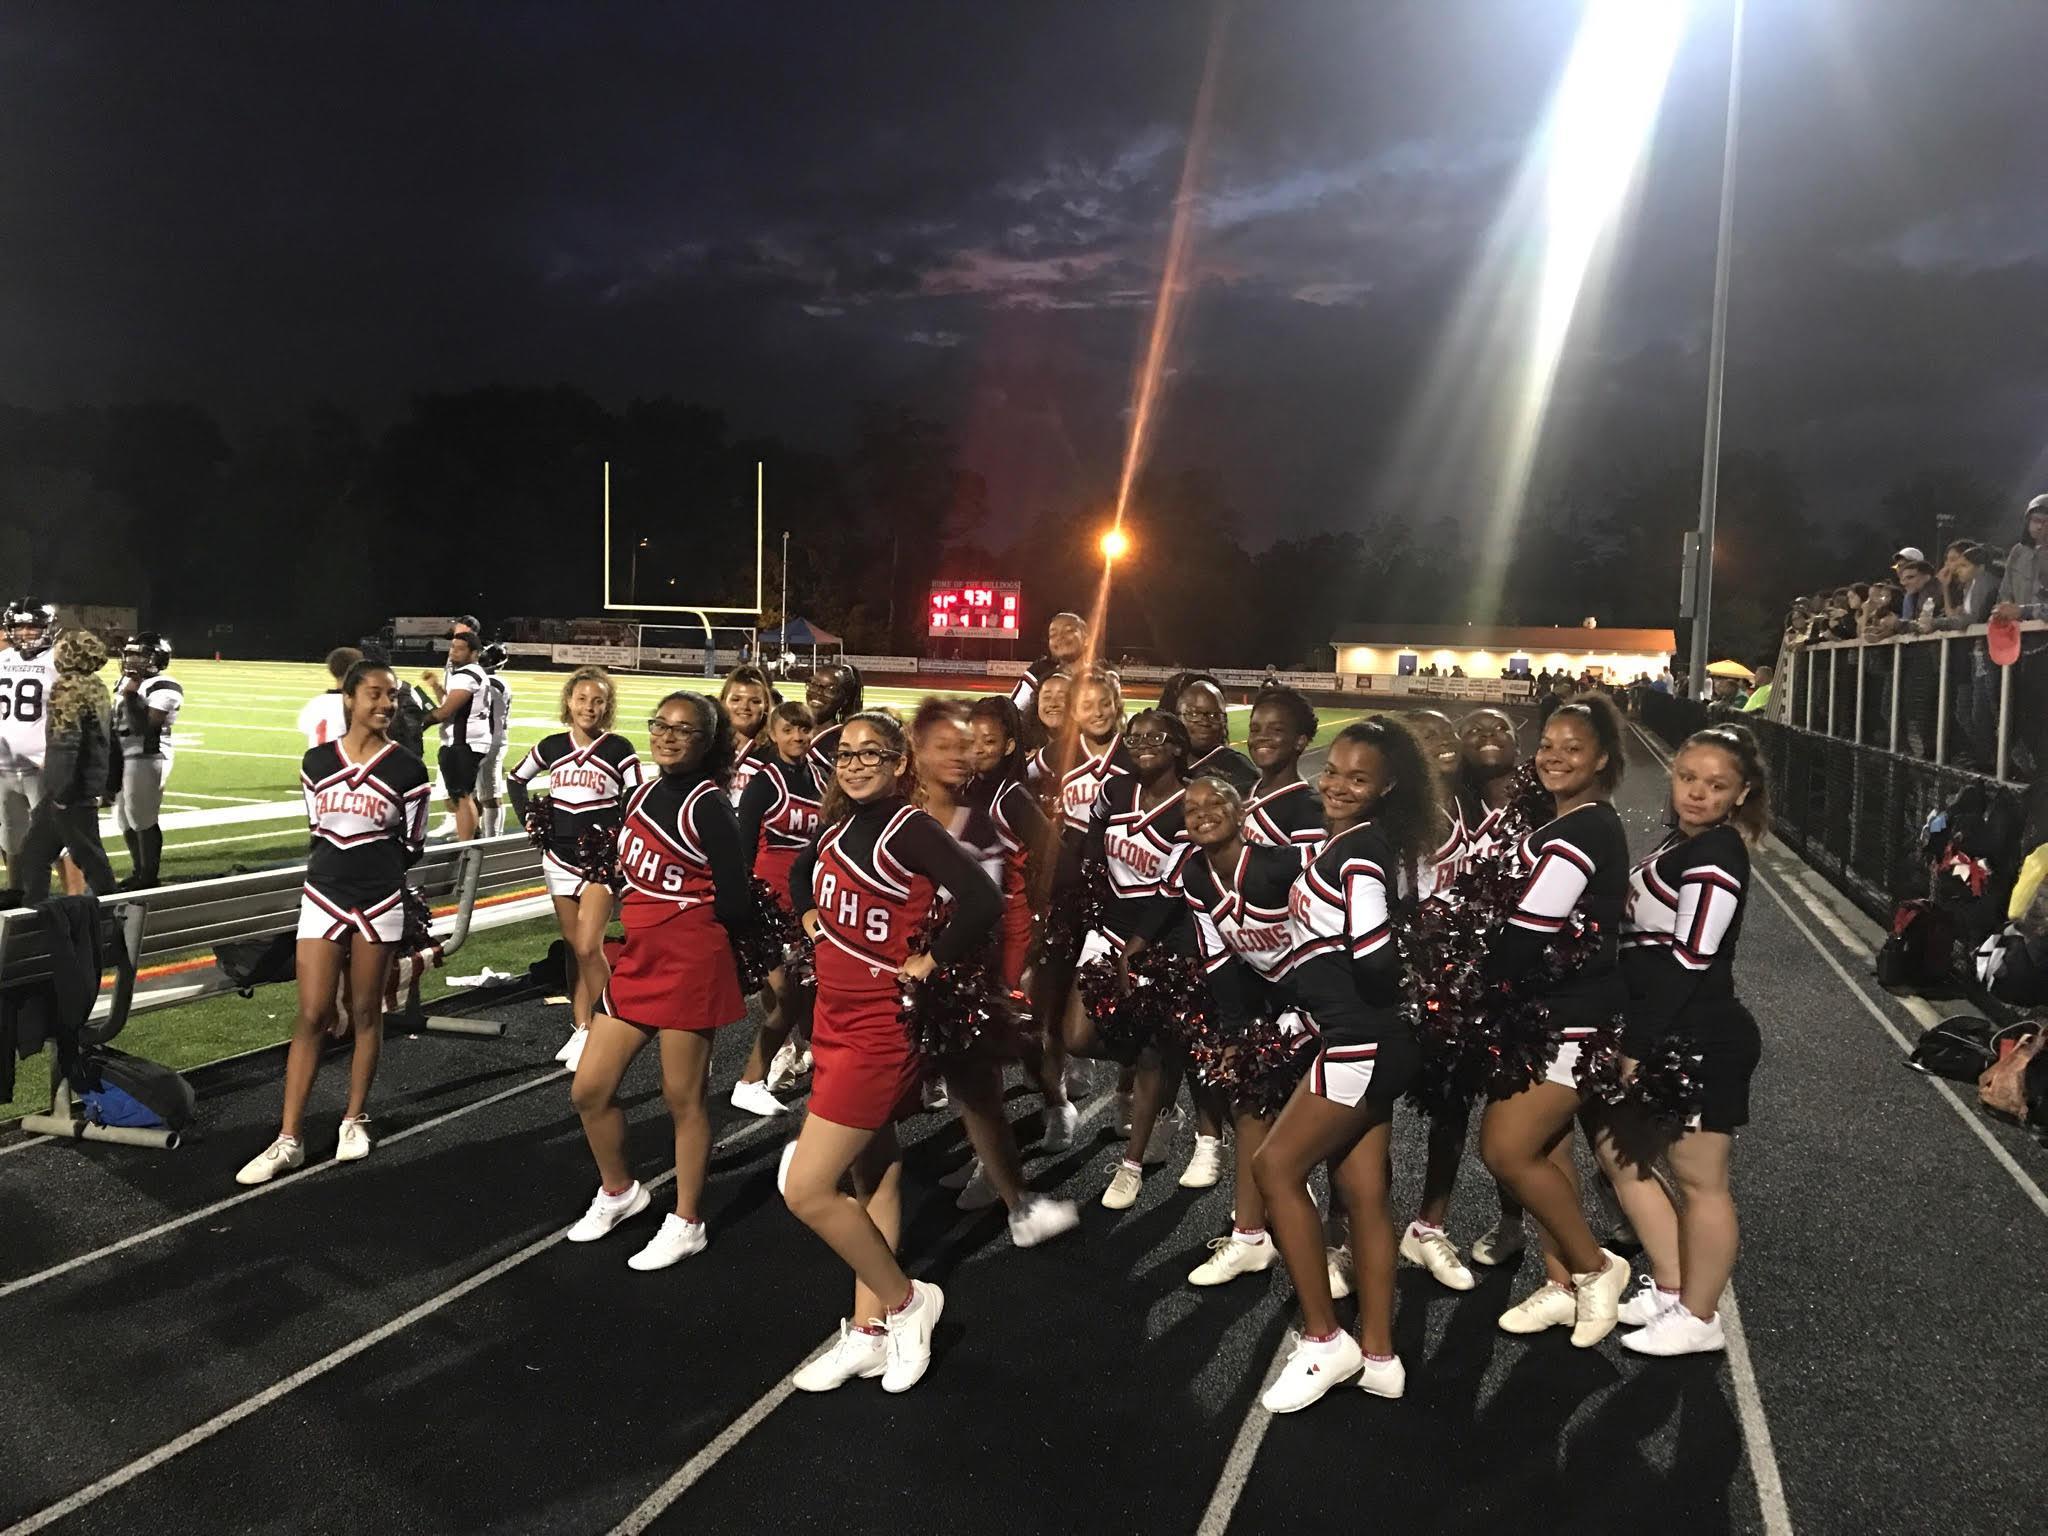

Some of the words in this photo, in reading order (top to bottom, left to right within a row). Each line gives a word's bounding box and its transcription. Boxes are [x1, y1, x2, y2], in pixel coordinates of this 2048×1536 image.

[2, 664, 46, 674] MANCHESTER
[551, 769, 606, 795] FALCONS
[316, 792, 388, 827] FALCONS
